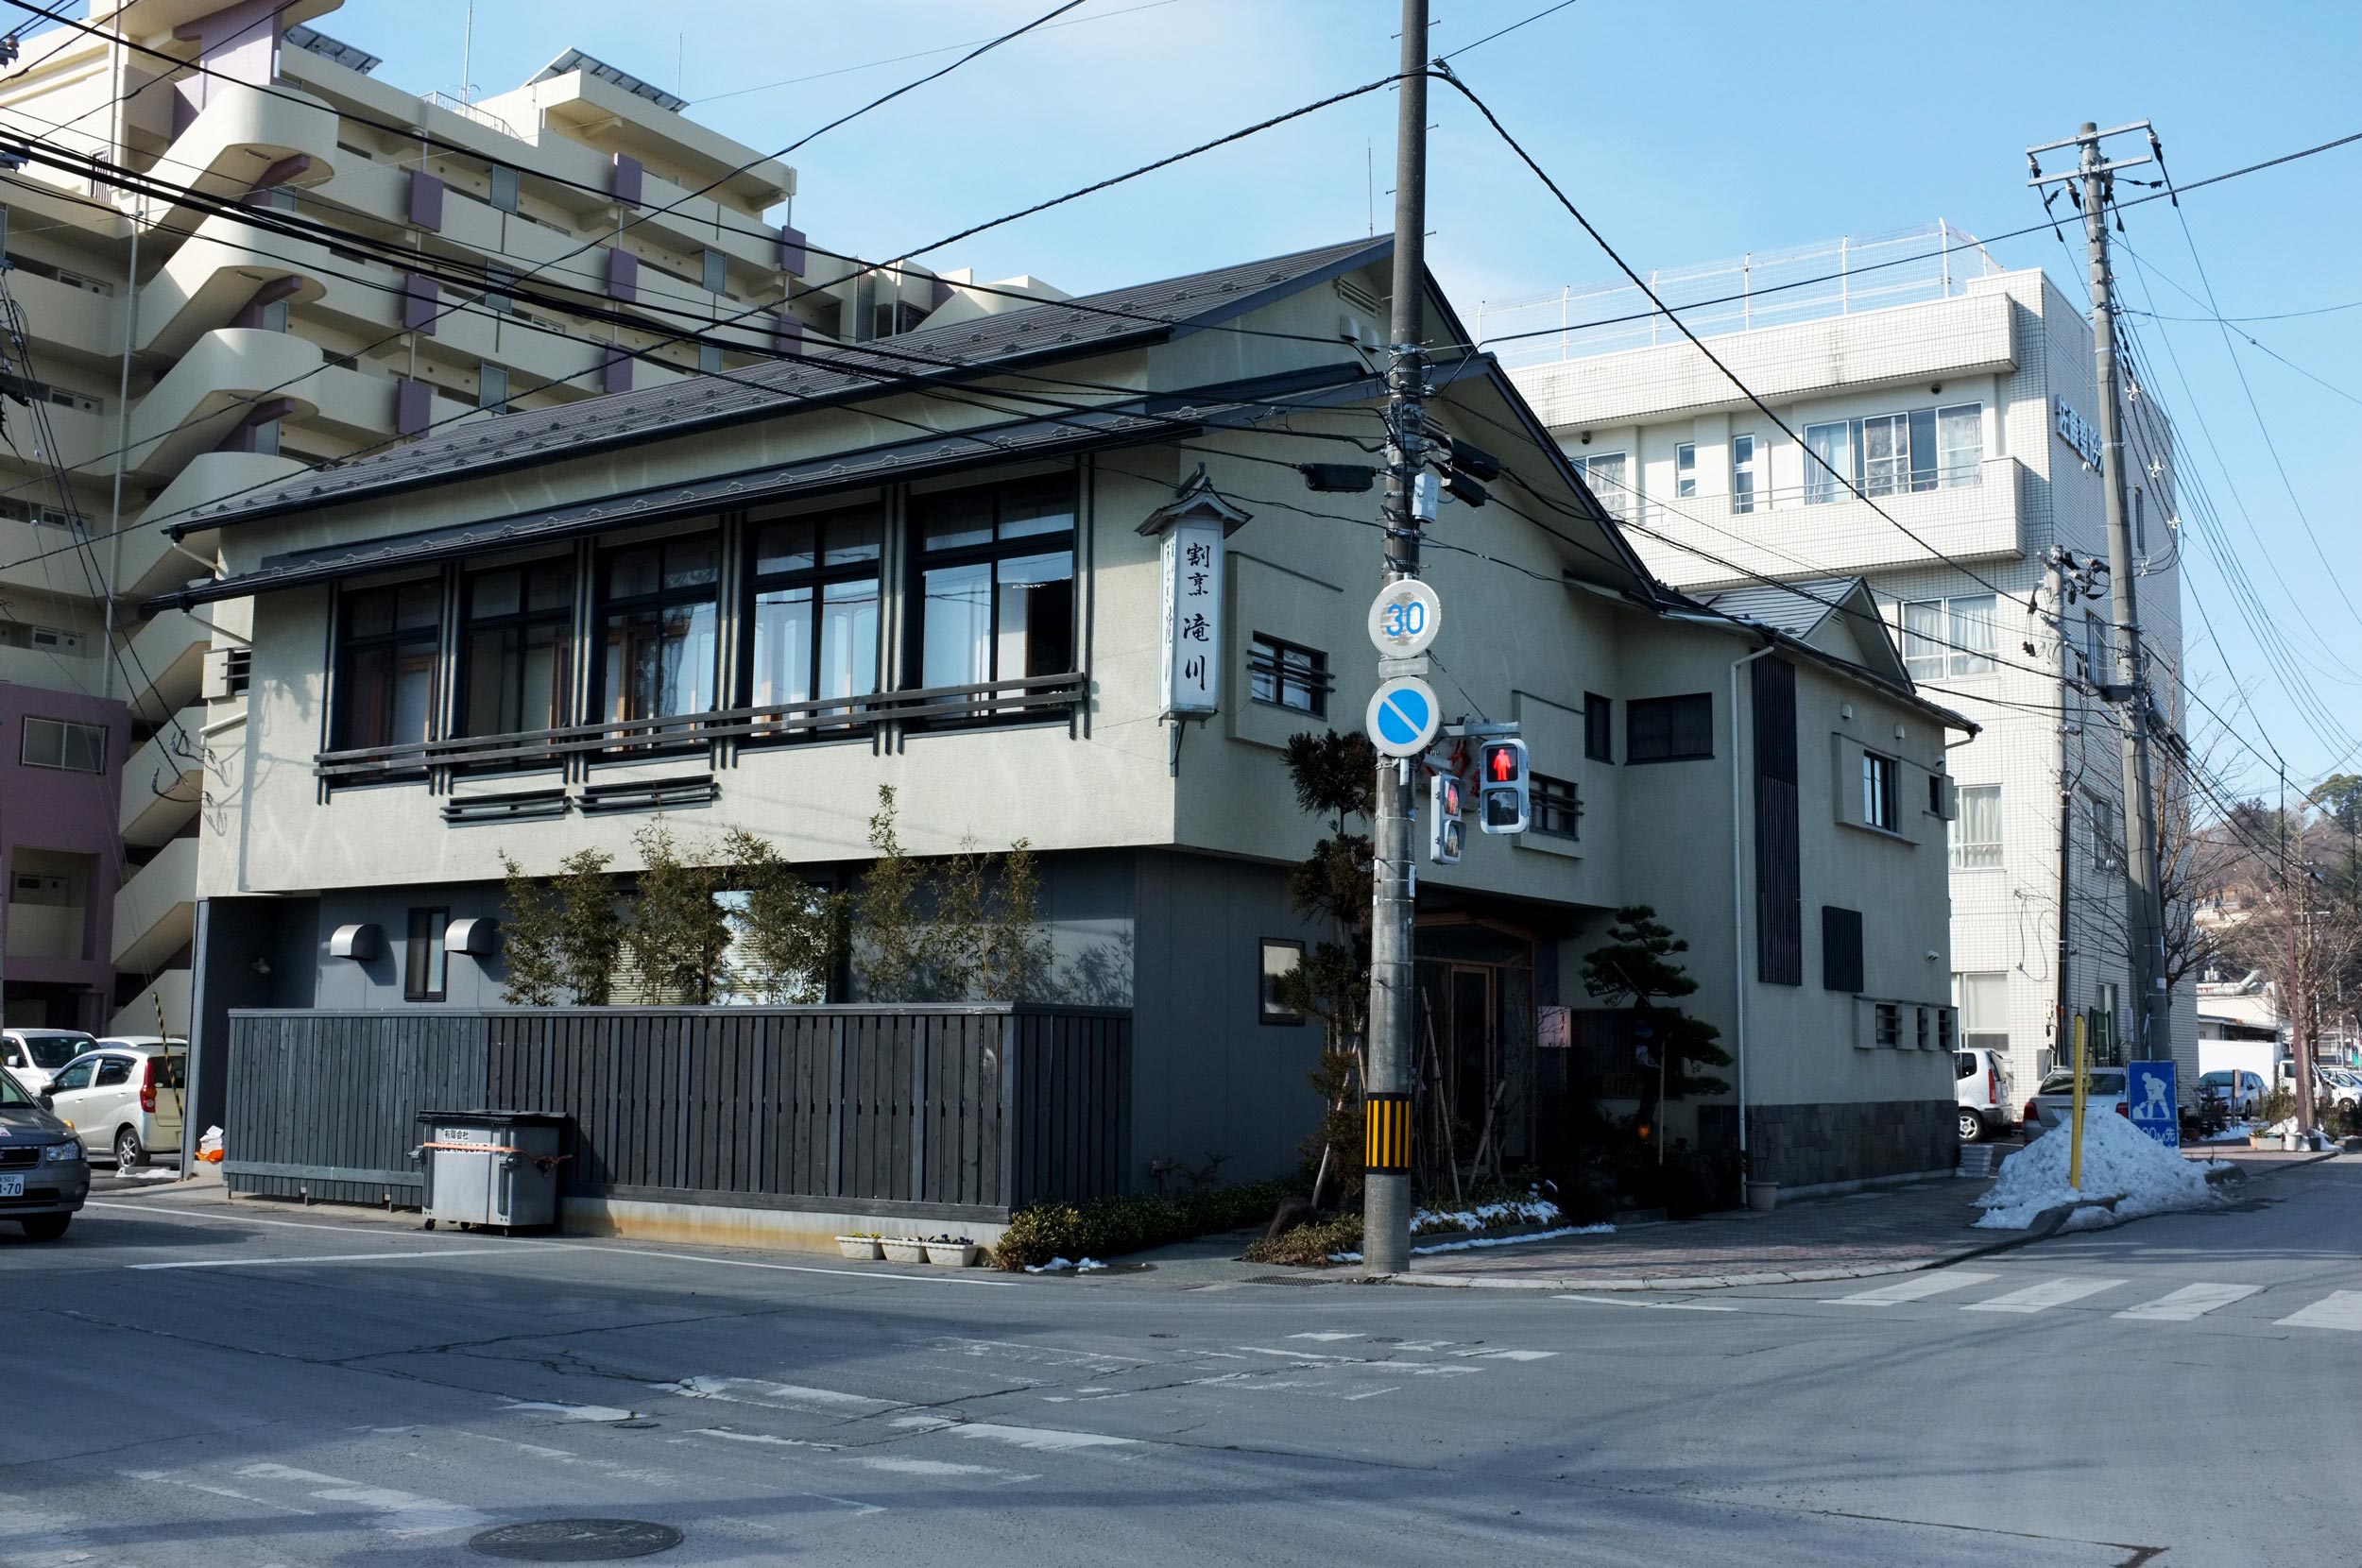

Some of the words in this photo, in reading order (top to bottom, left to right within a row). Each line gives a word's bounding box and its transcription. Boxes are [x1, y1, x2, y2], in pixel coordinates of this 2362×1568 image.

[1386, 601, 1425, 637] 30
[444, 1130, 470, 1140] 有限会社
